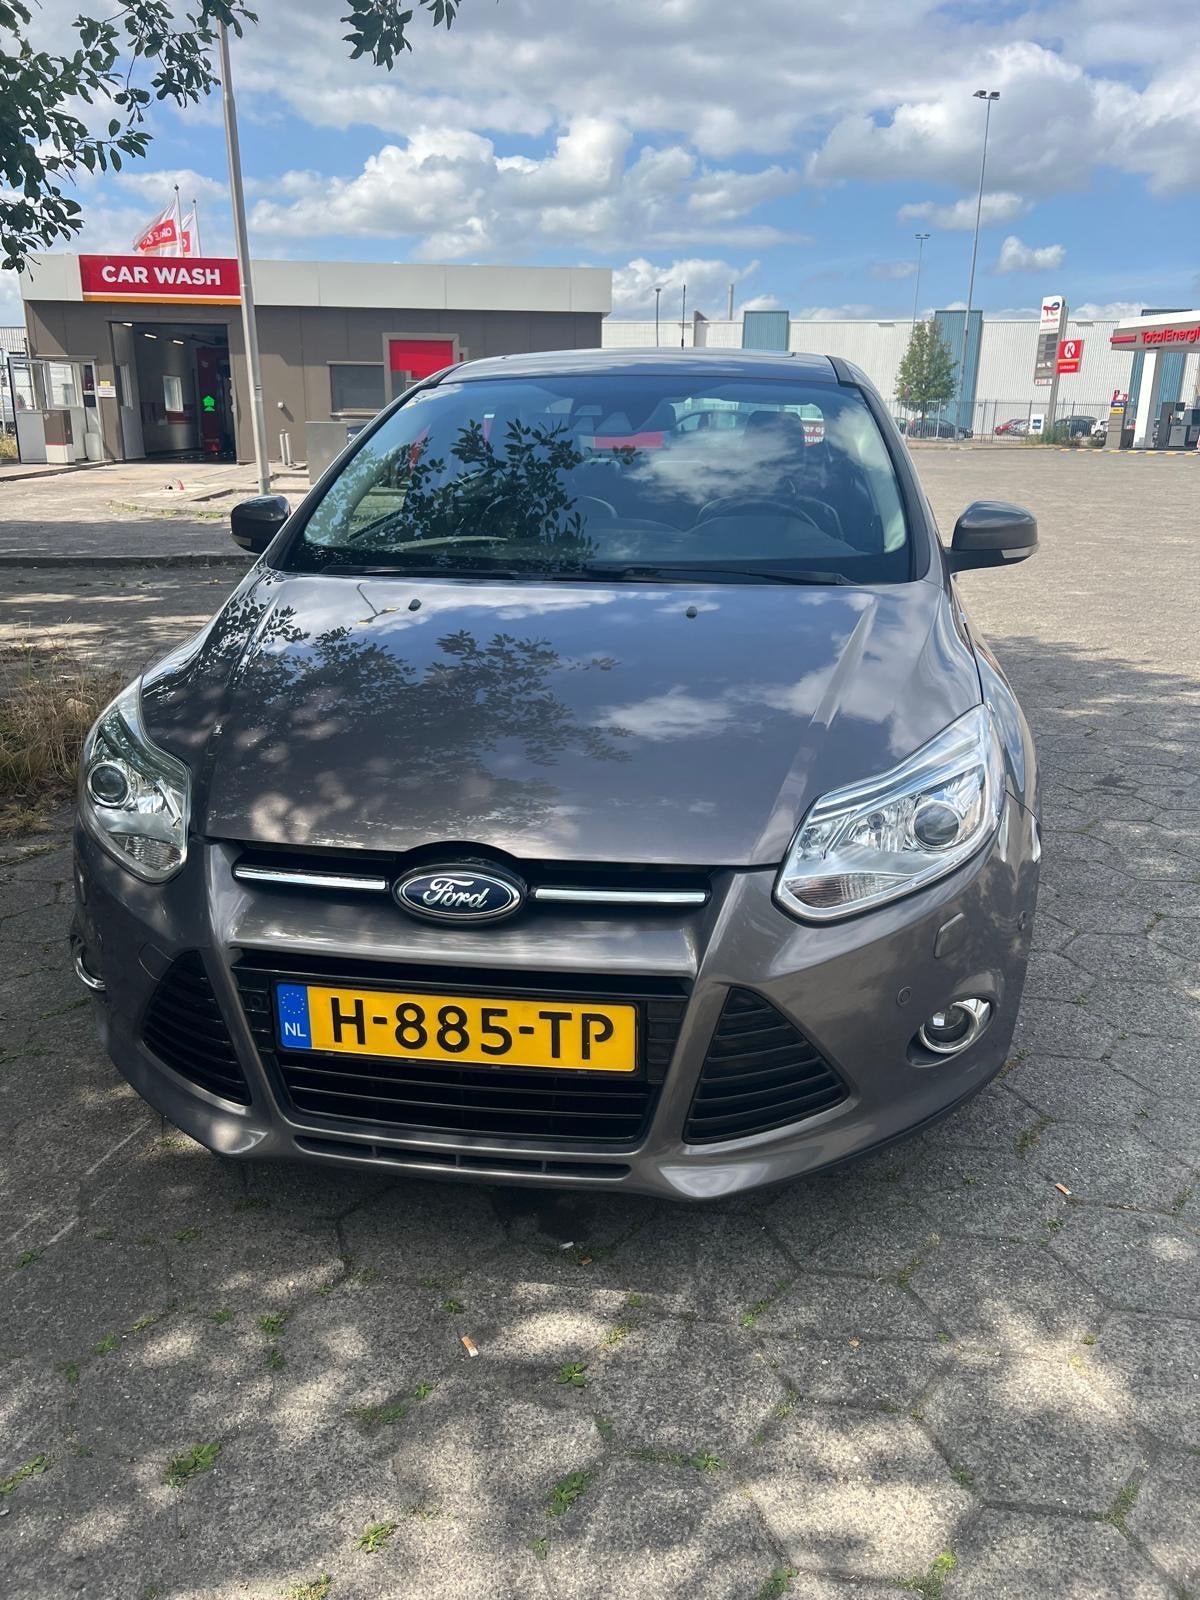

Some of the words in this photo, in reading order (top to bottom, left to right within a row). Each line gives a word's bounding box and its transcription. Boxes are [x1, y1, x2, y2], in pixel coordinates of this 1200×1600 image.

[101, 265, 149, 284] CAR
[153, 267, 221, 285] WASH
[422, 877, 490, 908] Ford
[284, 1021, 307, 1037] NL
[330, 996, 614, 1060] H-885-TP
